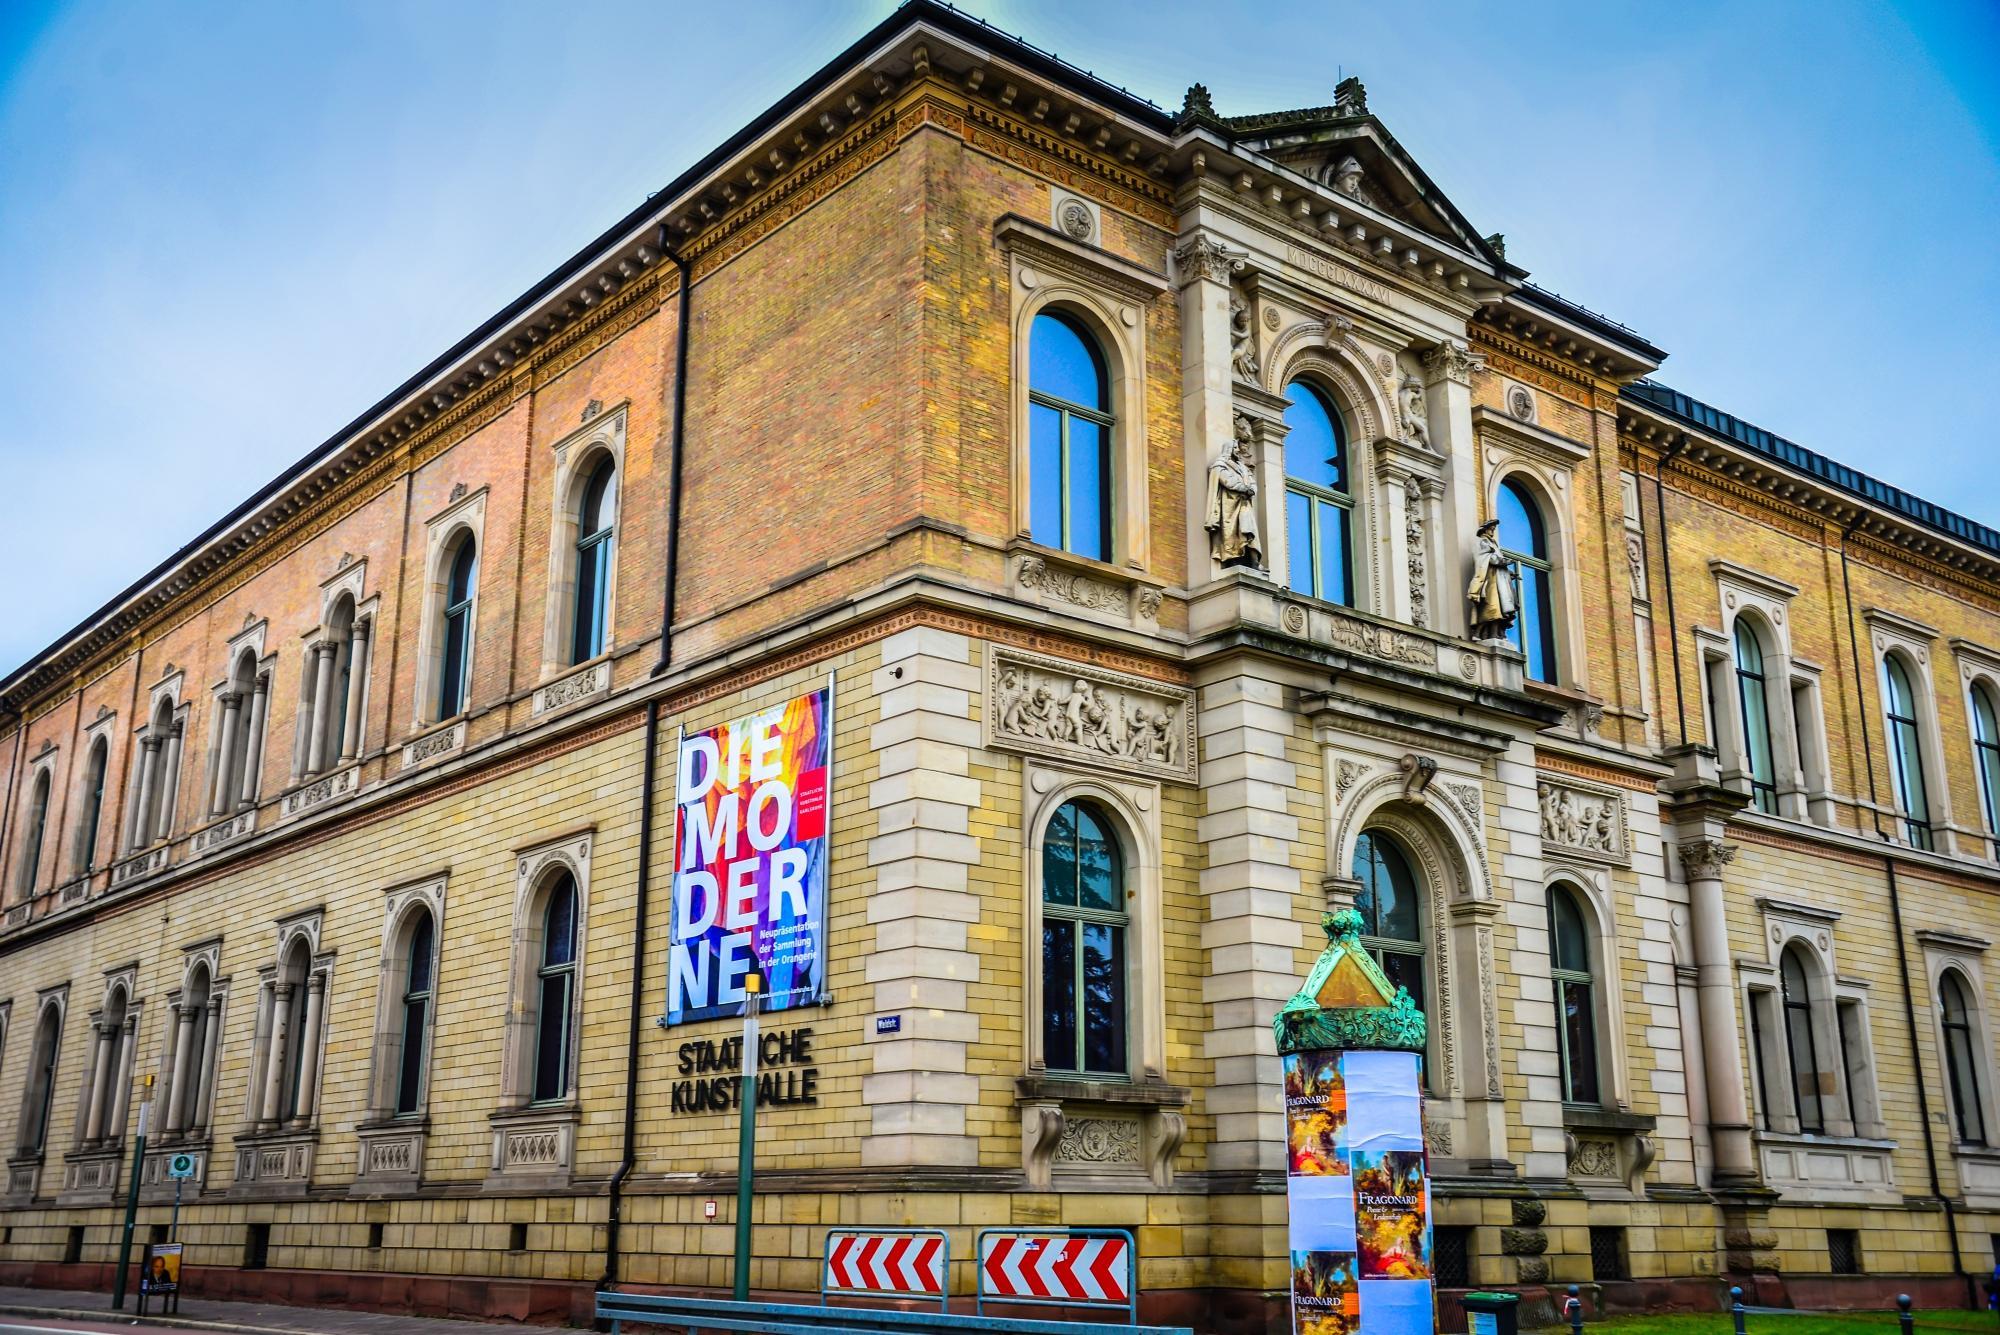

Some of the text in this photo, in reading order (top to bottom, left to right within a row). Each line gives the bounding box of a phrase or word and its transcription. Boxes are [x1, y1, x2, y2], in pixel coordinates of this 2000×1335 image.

[680, 713, 783, 804] DIE
[684, 780, 792, 870] MO
[677, 848, 807, 940] DER
[759, 937, 811, 953] der Sammlung
[760, 920, 819, 939] Neupräsentation
[668, 932, 752, 1012] NE
[759, 949, 817, 968] in der Orangerie
[678, 1028, 812, 1074] STAATICHE
[671, 1068, 817, 1113] KUNSTALLE
[1286, 1095, 1330, 1106] FRAGONARD
[1358, 1191, 1417, 1205] FRAGONARD
[1294, 1291, 1341, 1306] FRAGONARD
